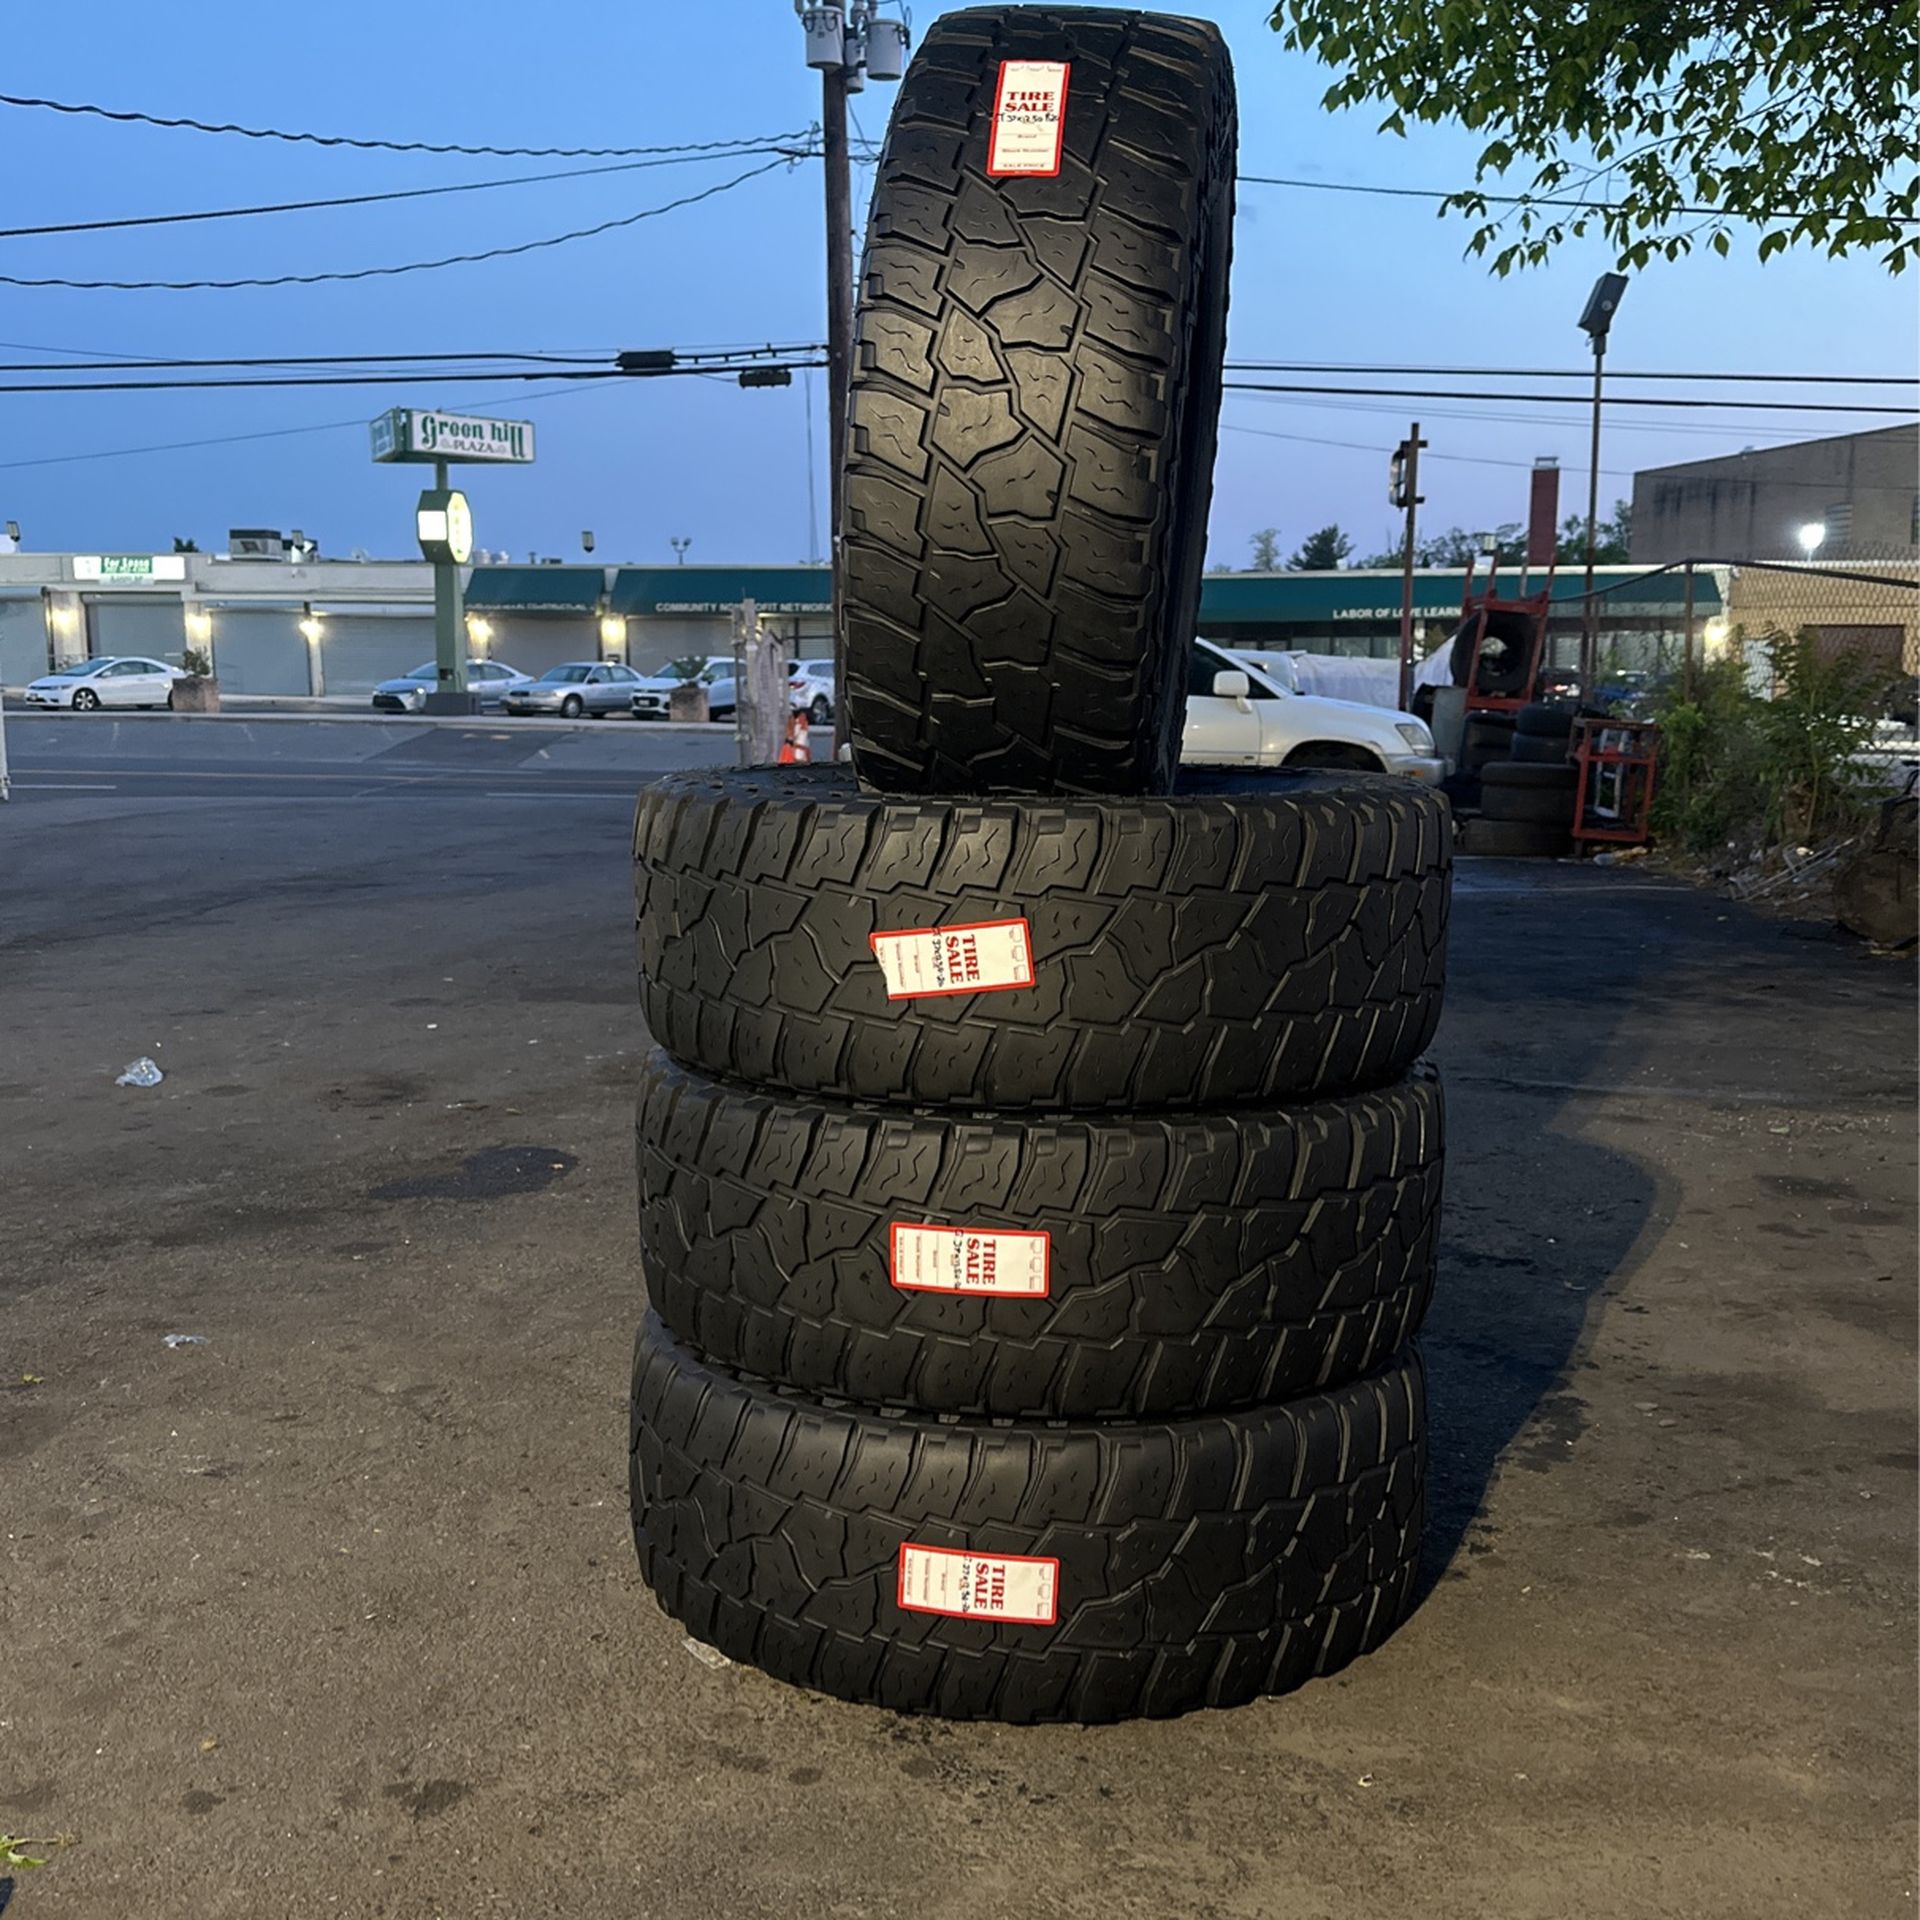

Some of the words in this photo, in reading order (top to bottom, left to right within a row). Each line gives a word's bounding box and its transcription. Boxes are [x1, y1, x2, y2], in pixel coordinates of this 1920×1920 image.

[1004, 102, 1055, 112] SALE
[1007, 91, 1055, 101] TIRE
[453, 439, 495, 453] PLAZA
[491, 422, 525, 459] hill
[655, 602, 718, 613] COMMUNITY
[1332, 608, 1373, 620] LABOR
[1375, 608, 1390, 619] OF
[945, 936, 964, 984] SALE
[962, 934, 981, 982] TIRE
[966, 1237, 980, 1284] SALE
[983, 1239, 997, 1285] TIRE
[974, 1562, 989, 1609] SALE
[990, 1564, 1005, 1610] TIRE
